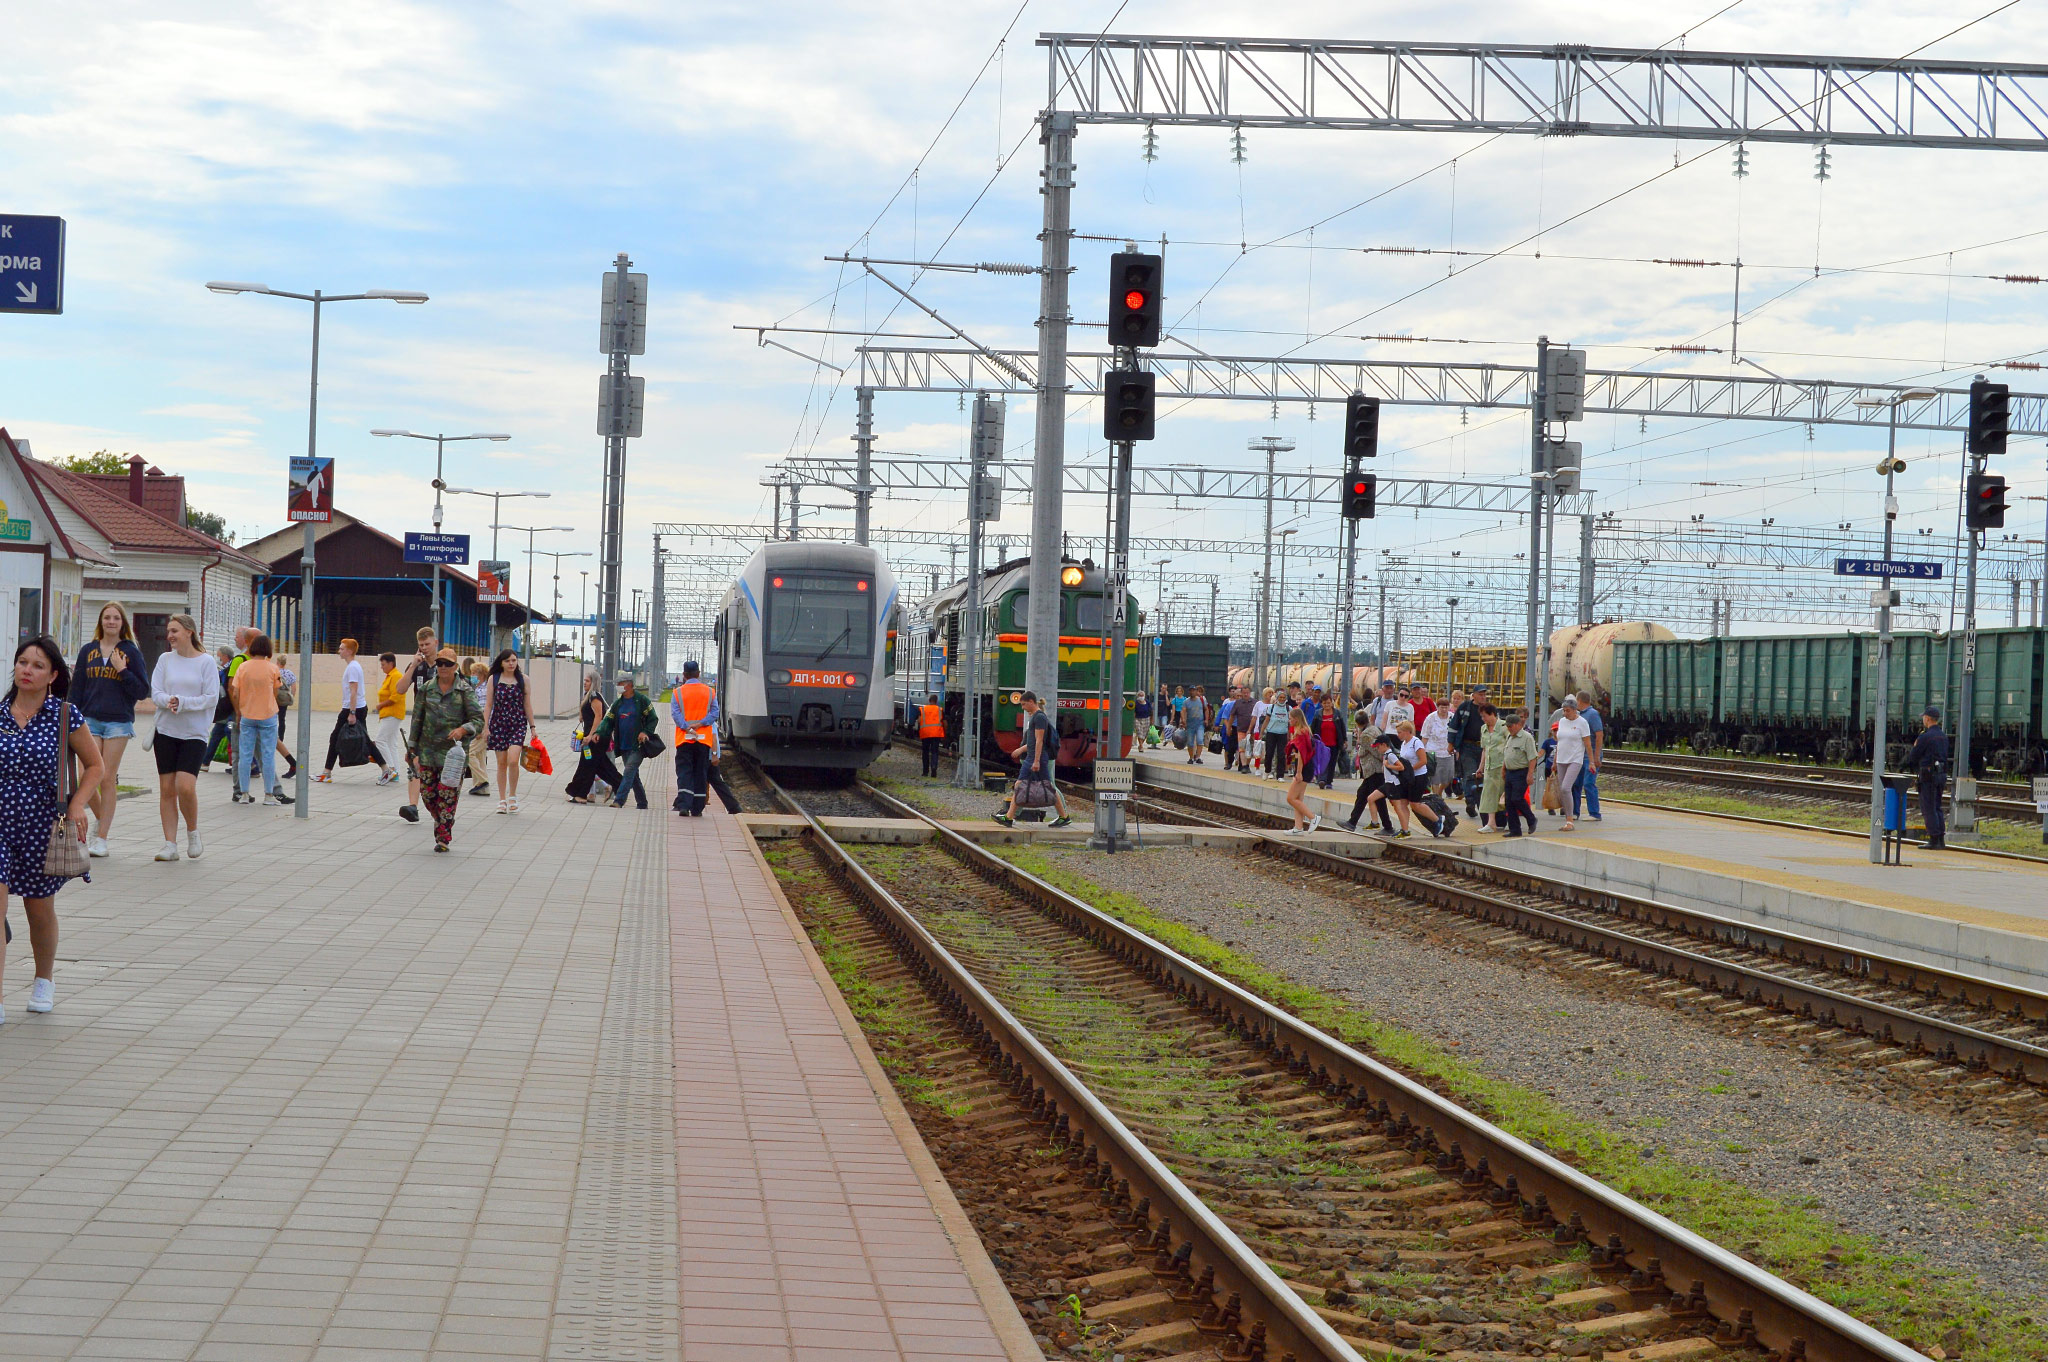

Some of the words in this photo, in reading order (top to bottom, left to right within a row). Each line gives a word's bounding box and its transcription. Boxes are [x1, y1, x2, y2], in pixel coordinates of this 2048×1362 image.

[291, 510, 329, 521] ОПАСНО!
[419, 534, 440, 542] Левы
[441, 535, 456, 543] бок
[422, 545, 464, 553] платформа
[1864, 562, 1872, 572] 2
[1881, 563, 1907, 575] Пуць
[1908, 564, 1916, 574] 3
[1115, 555, 1127, 621] НМ1А
[794, 673, 809, 683] ДП
[823, 675, 841, 685] 001
